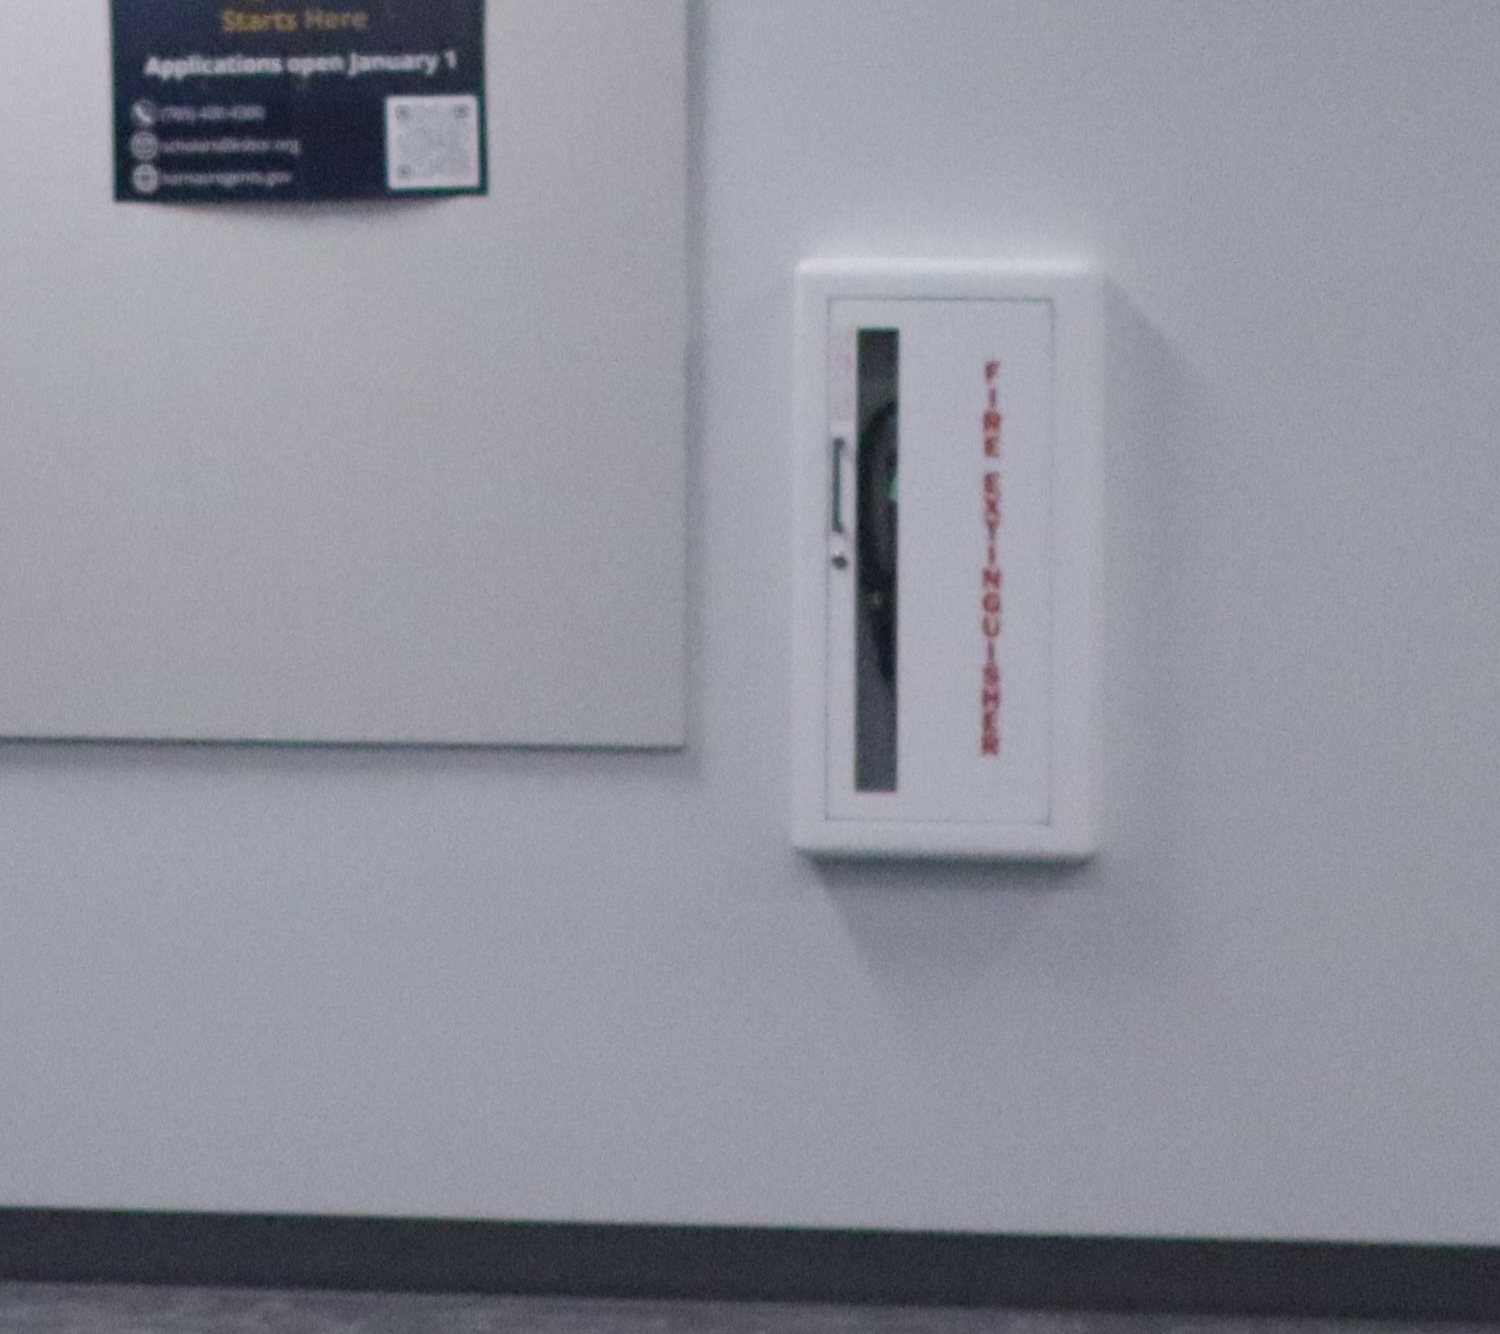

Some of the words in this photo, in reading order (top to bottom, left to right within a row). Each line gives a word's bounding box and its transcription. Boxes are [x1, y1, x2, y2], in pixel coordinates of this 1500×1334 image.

[222, 9, 297, 32] Starts
[304, 8, 370, 31] Here
[145, 55, 283, 82] Applications
[287, 57, 346, 78] open
[347, 52, 439, 77] January
[444, 49, 457, 69] 1
[983, 360, 1002, 457] FIRE
[981, 472, 1003, 756] EXTINGUISHER
